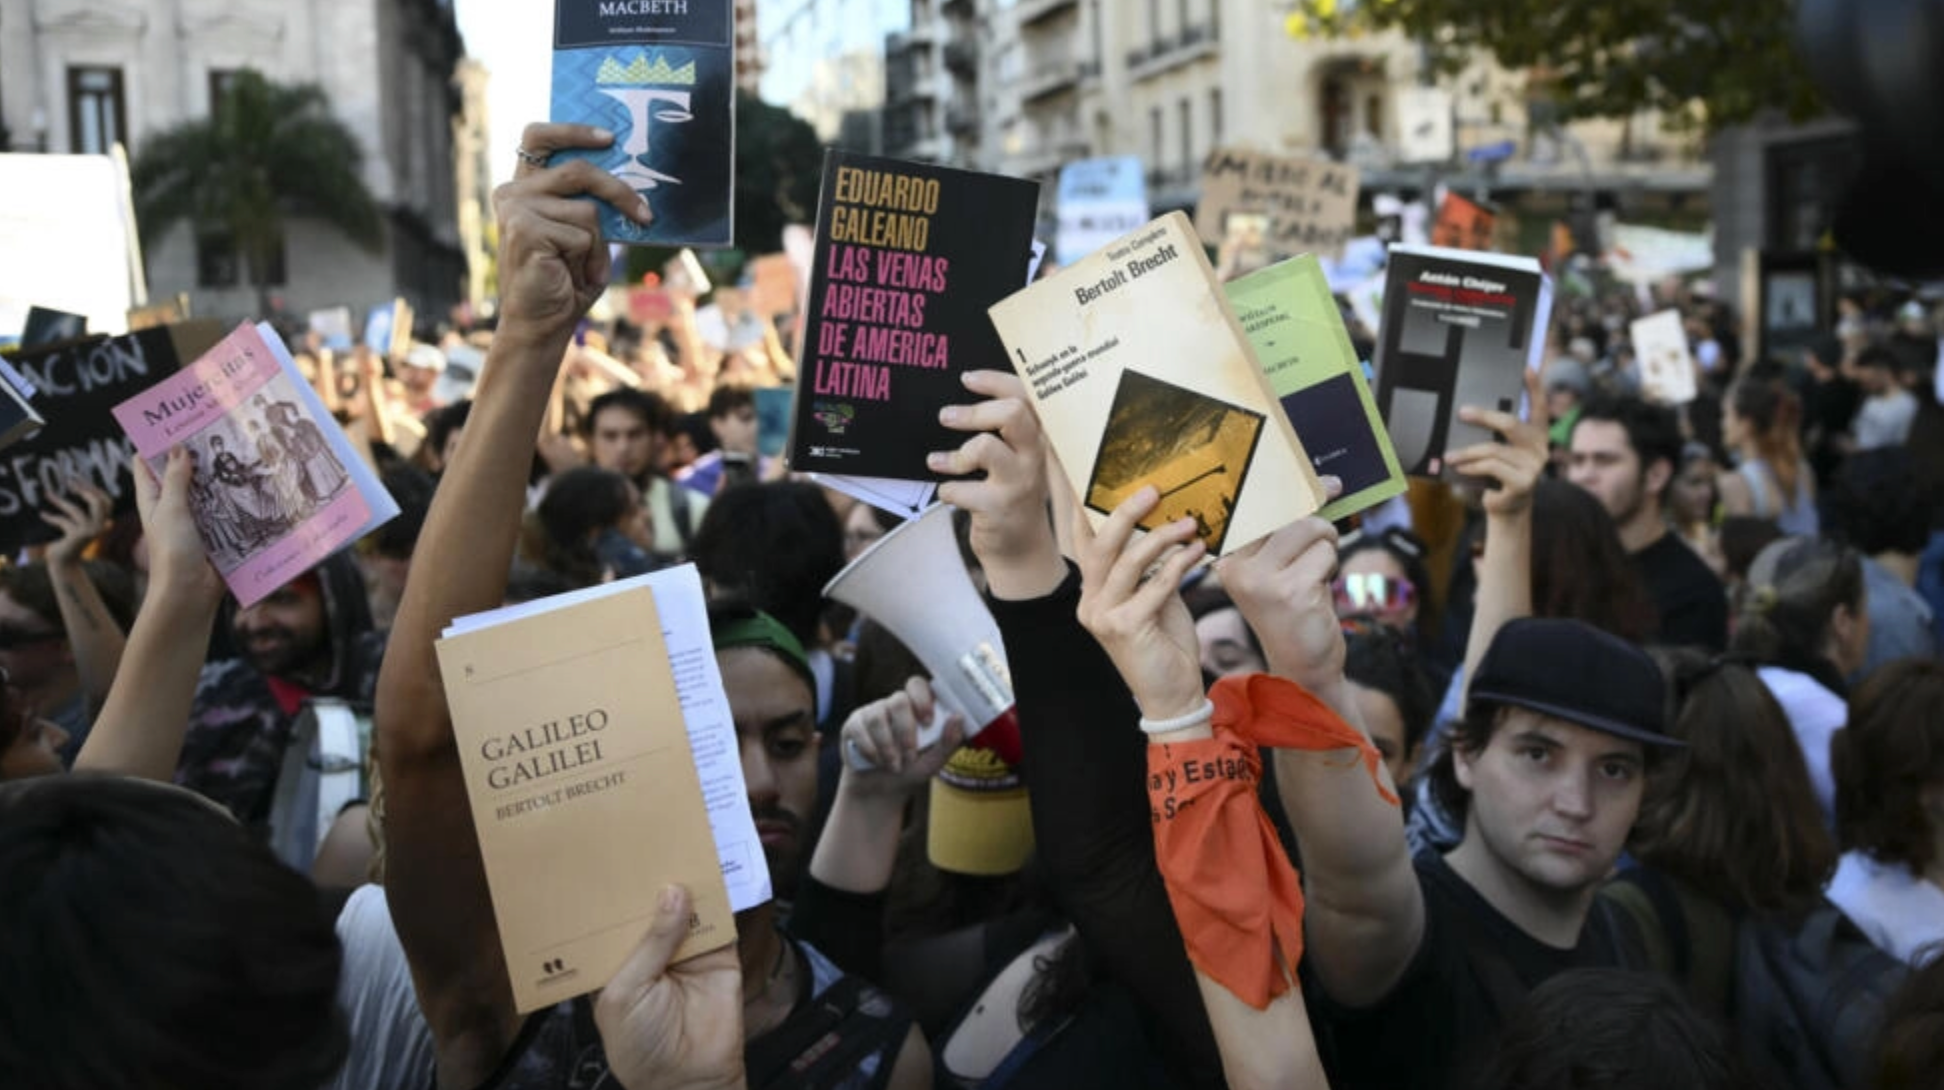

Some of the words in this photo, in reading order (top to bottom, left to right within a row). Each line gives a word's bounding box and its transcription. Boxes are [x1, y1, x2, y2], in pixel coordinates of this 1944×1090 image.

[599, 0, 688, 16] MACBETH
[835, 166, 940, 215] EDUARDO
[831, 206, 929, 252] GALEANO
[827, 244, 870, 283] LAS
[877, 251, 949, 293] VENAS
[1074, 270, 1128, 306] Bertolt
[1127, 244, 1178, 279] Brecht
[823, 283, 926, 328] ABIERTAS
[818, 321, 848, 358] DE
[1016, 347, 1027, 363] 1
[143, 349, 254, 427] Mujercitas
[814, 360, 891, 401] LATINA
[480, 708, 608, 762] GALILEO
[487, 739, 603, 790] GALILEI
[1165, 769, 1177, 793] y
[495, 789, 564, 821] BERTOLT
[565, 770, 626, 800] BRECHT
